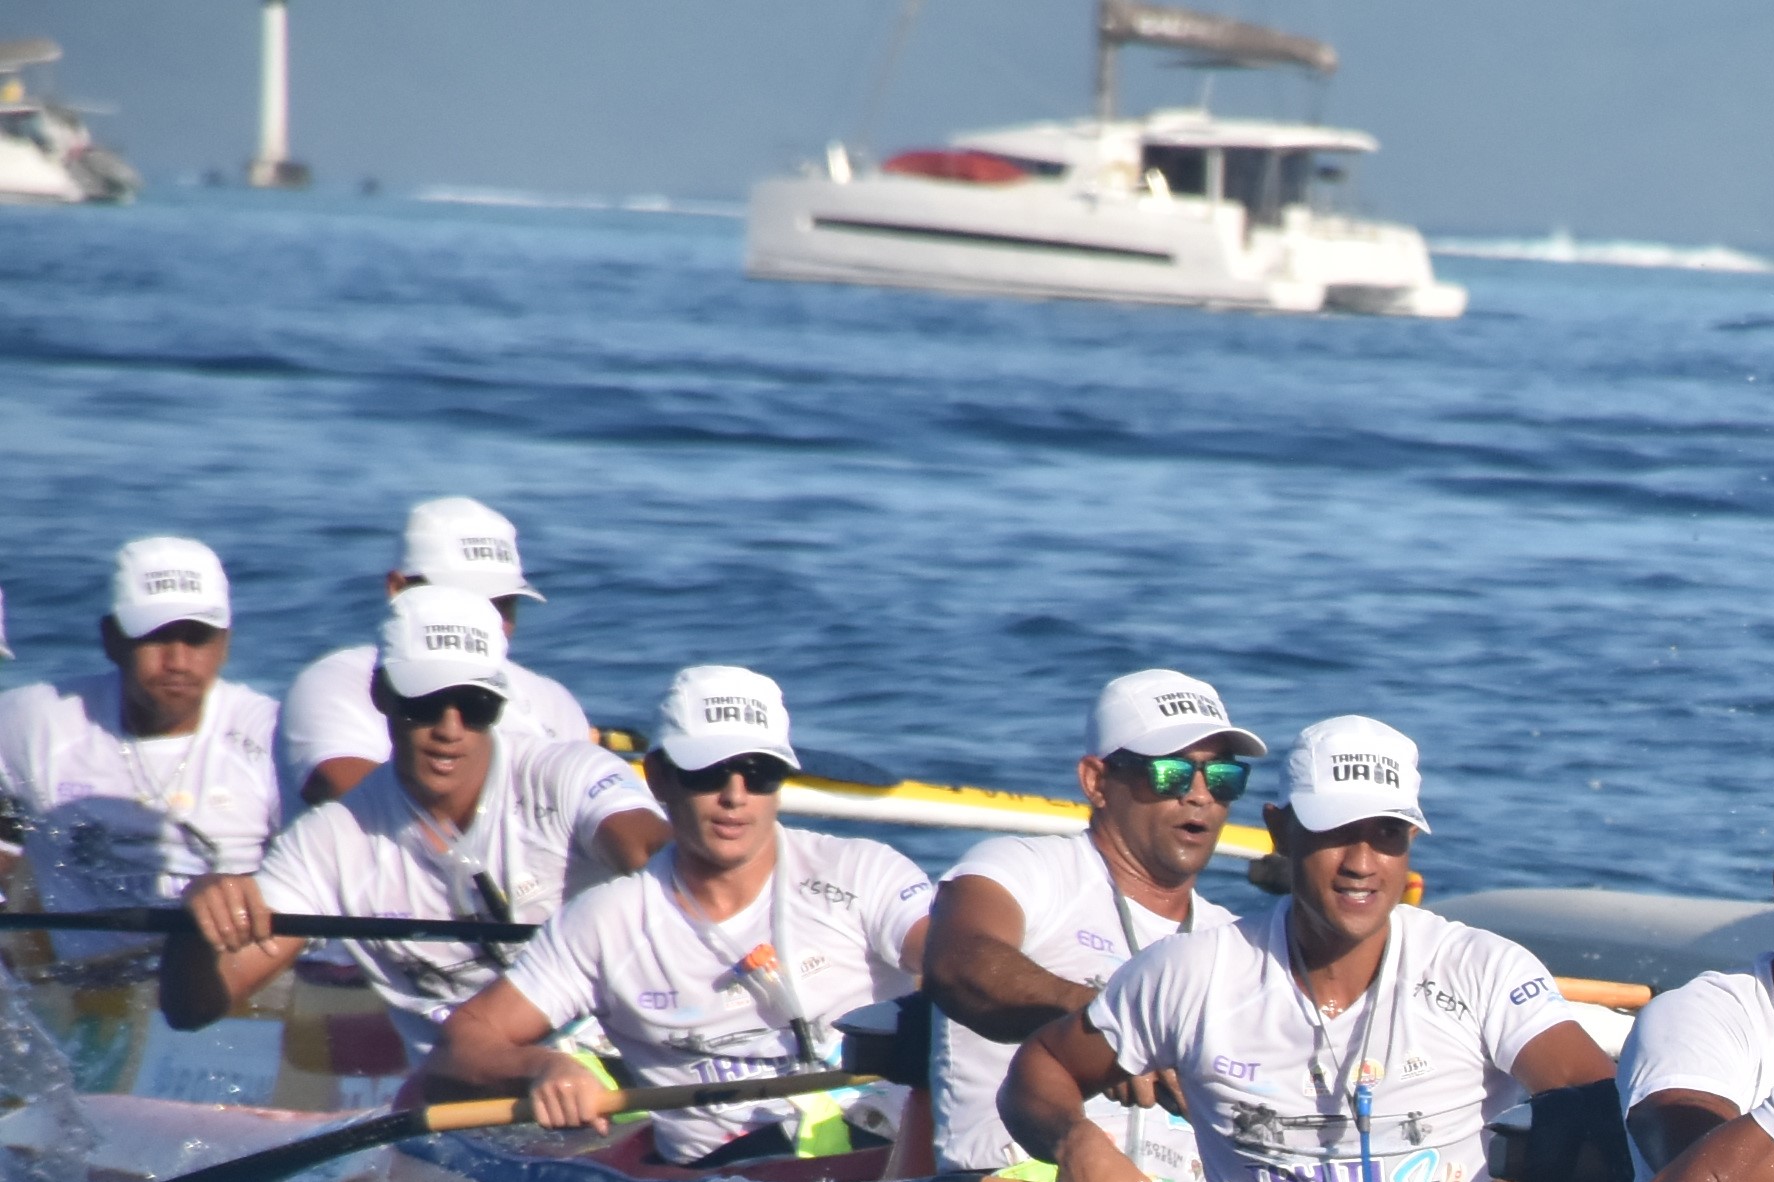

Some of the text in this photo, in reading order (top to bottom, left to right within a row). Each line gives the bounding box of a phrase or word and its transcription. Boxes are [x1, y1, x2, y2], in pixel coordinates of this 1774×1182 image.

[1330, 753, 1379, 765] TAHITI
[1077, 929, 1115, 954] EDT
[637, 990, 680, 1011] EDT
[1508, 976, 1550, 1006] EDT
[1435, 990, 1471, 1020] EDT
[1212, 1055, 1262, 1083] EDT
